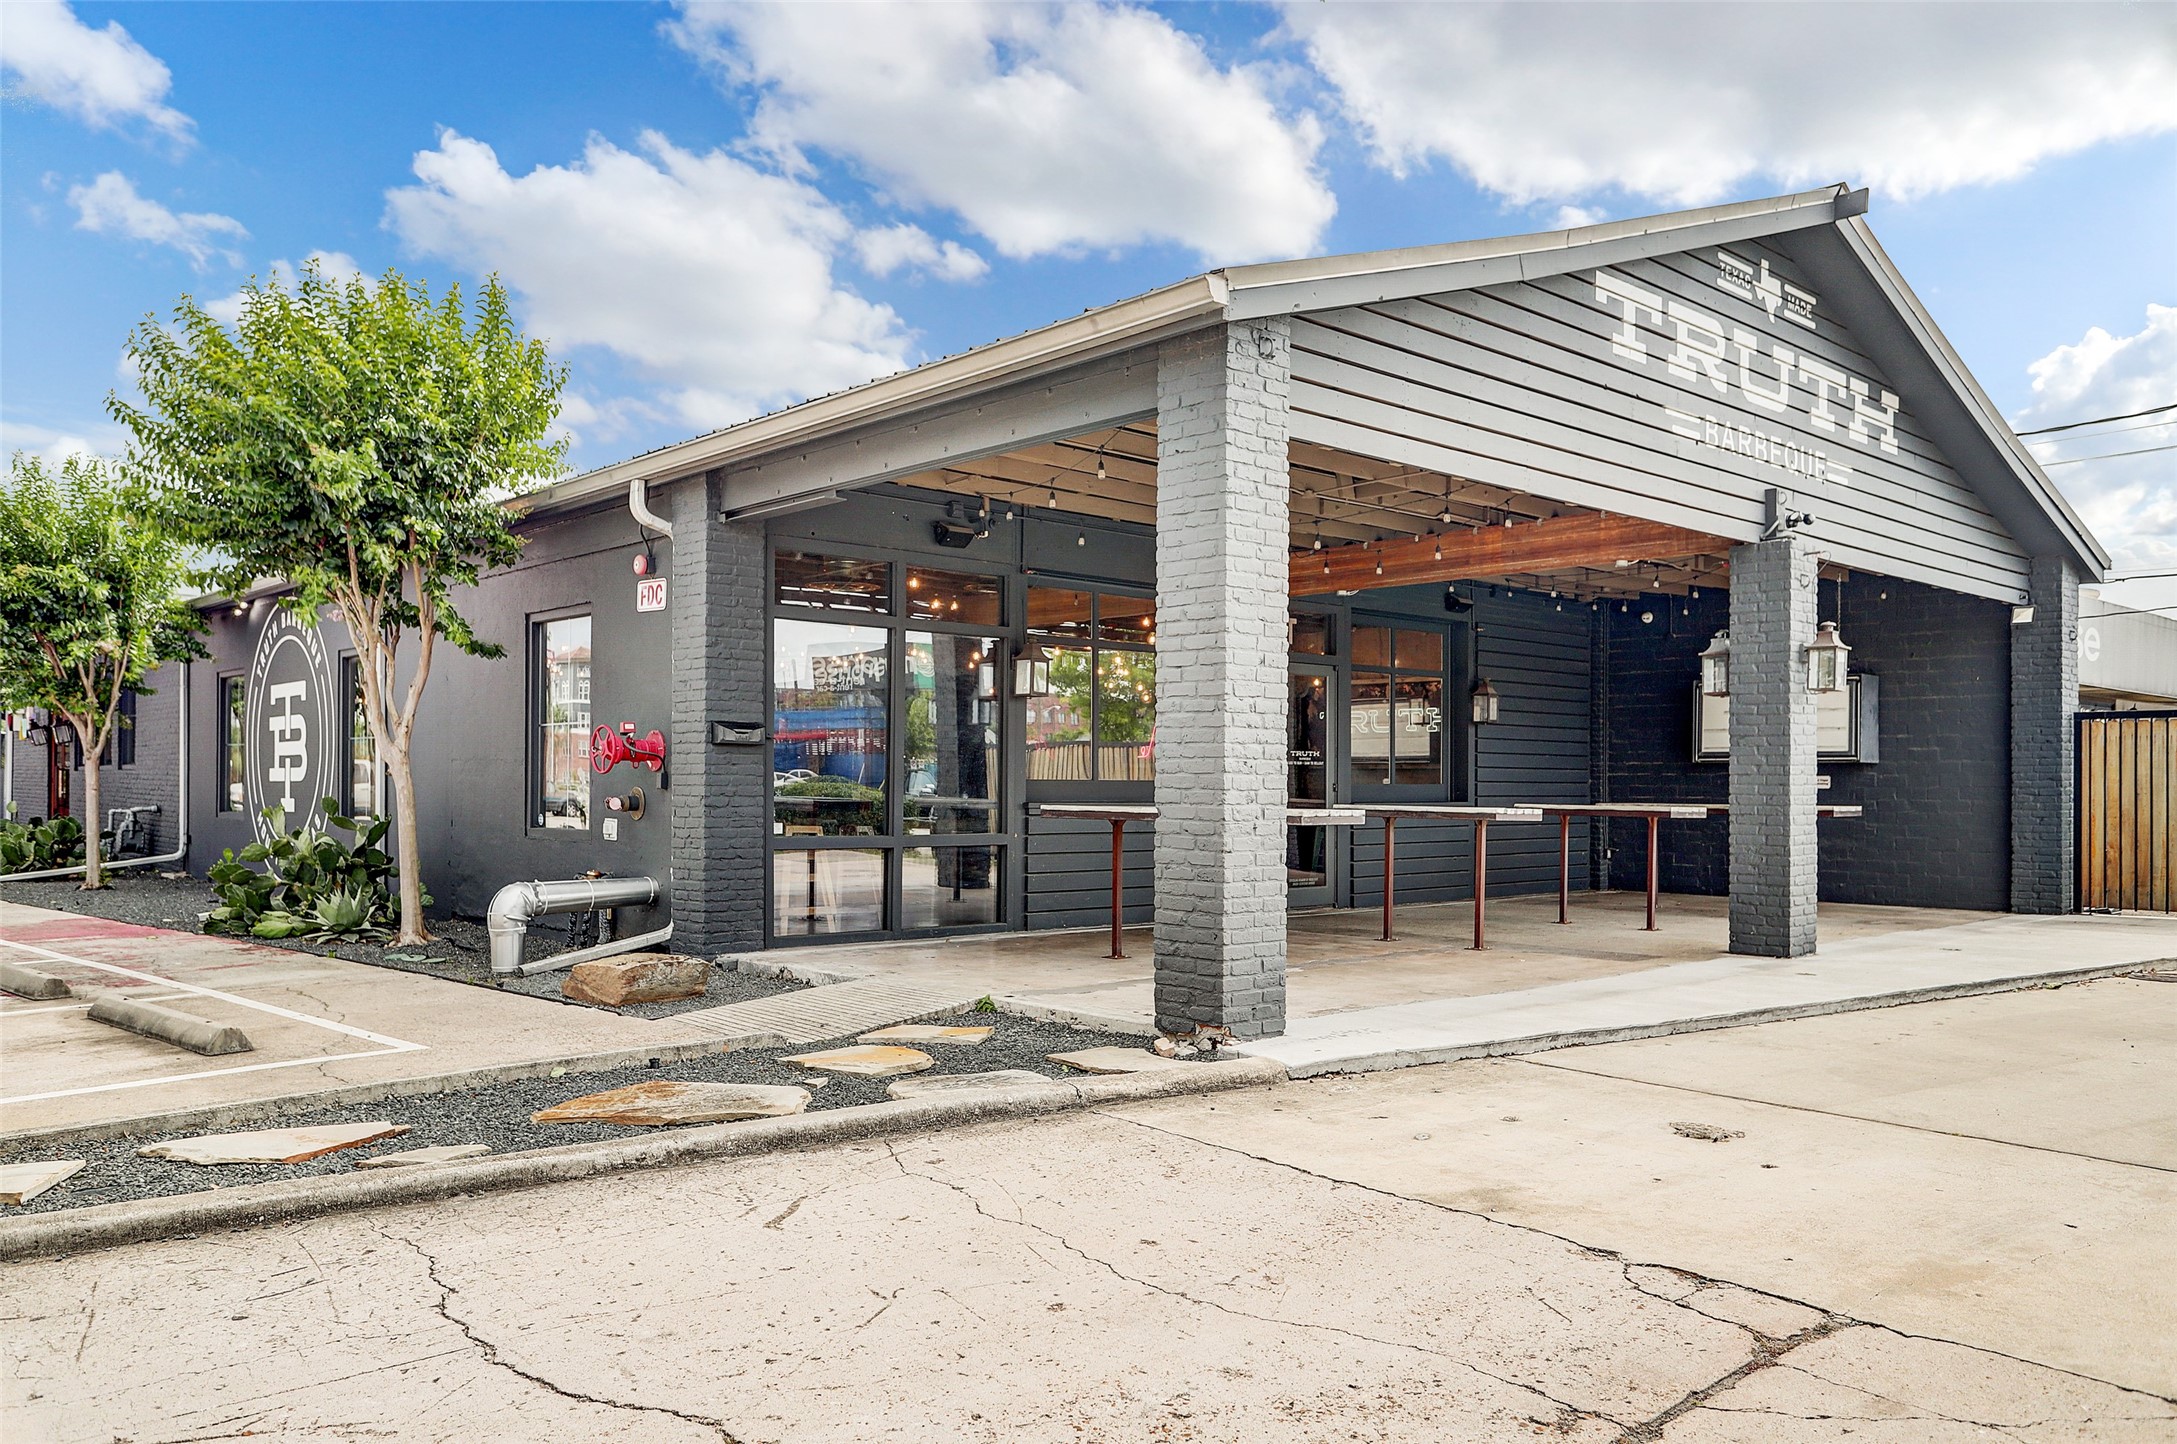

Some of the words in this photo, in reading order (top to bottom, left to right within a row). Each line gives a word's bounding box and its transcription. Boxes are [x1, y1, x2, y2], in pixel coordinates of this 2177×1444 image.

[1719, 261, 1752, 290] TEXAS
[1787, 295, 1813, 319] MADE
[1594, 269, 1900, 456] TRUTH
[1705, 414, 1827, 483] BARBEQUE
[640, 584, 663, 607] FDC
[256, 620, 279, 678] TRUTH
